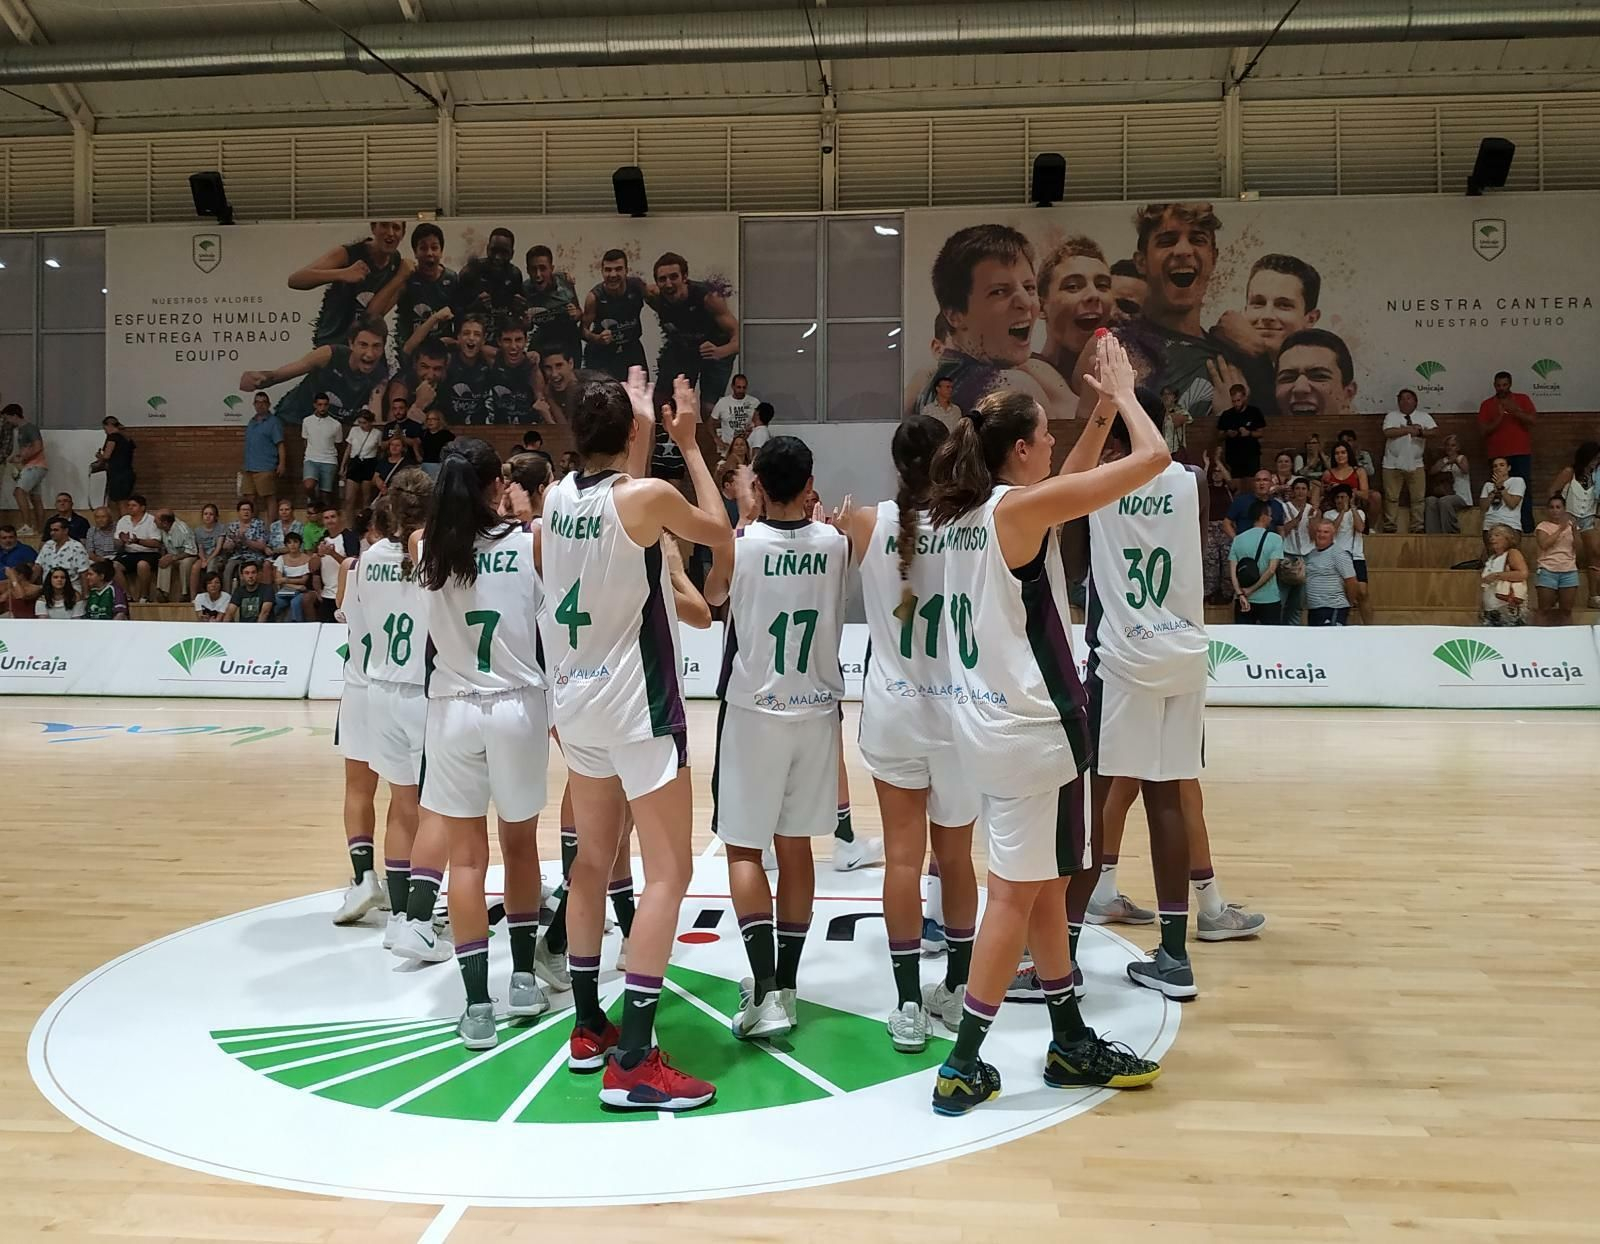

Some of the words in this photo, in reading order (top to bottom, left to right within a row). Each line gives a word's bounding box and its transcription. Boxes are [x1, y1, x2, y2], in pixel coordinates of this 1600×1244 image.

[214, 296, 263, 304] VALORES
[1387, 299, 1482, 311] NUESTRA
[1496, 297, 1593, 309] CANTERA
[114, 313, 203, 326] ESFUERZO
[213, 311, 302, 324] HUMILDAD
[1415, 318, 1489, 328] NUESTRO
[1500, 317, 1565, 326] FUTURO
[125, 332, 203, 344] ENTREGA
[213, 330, 291, 342] TRABAJO
[175, 350, 239, 362] EQUIPO
[1118, 494, 1174, 516] NDOYE
[885, 534, 945, 555] MSIA
[946, 526, 988, 551] MATOSO
[476, 550, 519, 575] NEZ
[764, 549, 828, 576] LIÑAN
[1122, 546, 1172, 609] 30
[554, 576, 592, 650] 4
[892, 594, 944, 659] 11
[950, 592, 979, 669] 10
[383, 612, 414, 666] 18
[464, 609, 501, 673] 7
[768, 609, 819, 675] 17
[1, 656, 67, 675] Unicaja
[219, 659, 289, 679] Unicaja
[1246, 662, 1328, 683] Unicaja
[1502, 661, 1584, 681] Unicaja
